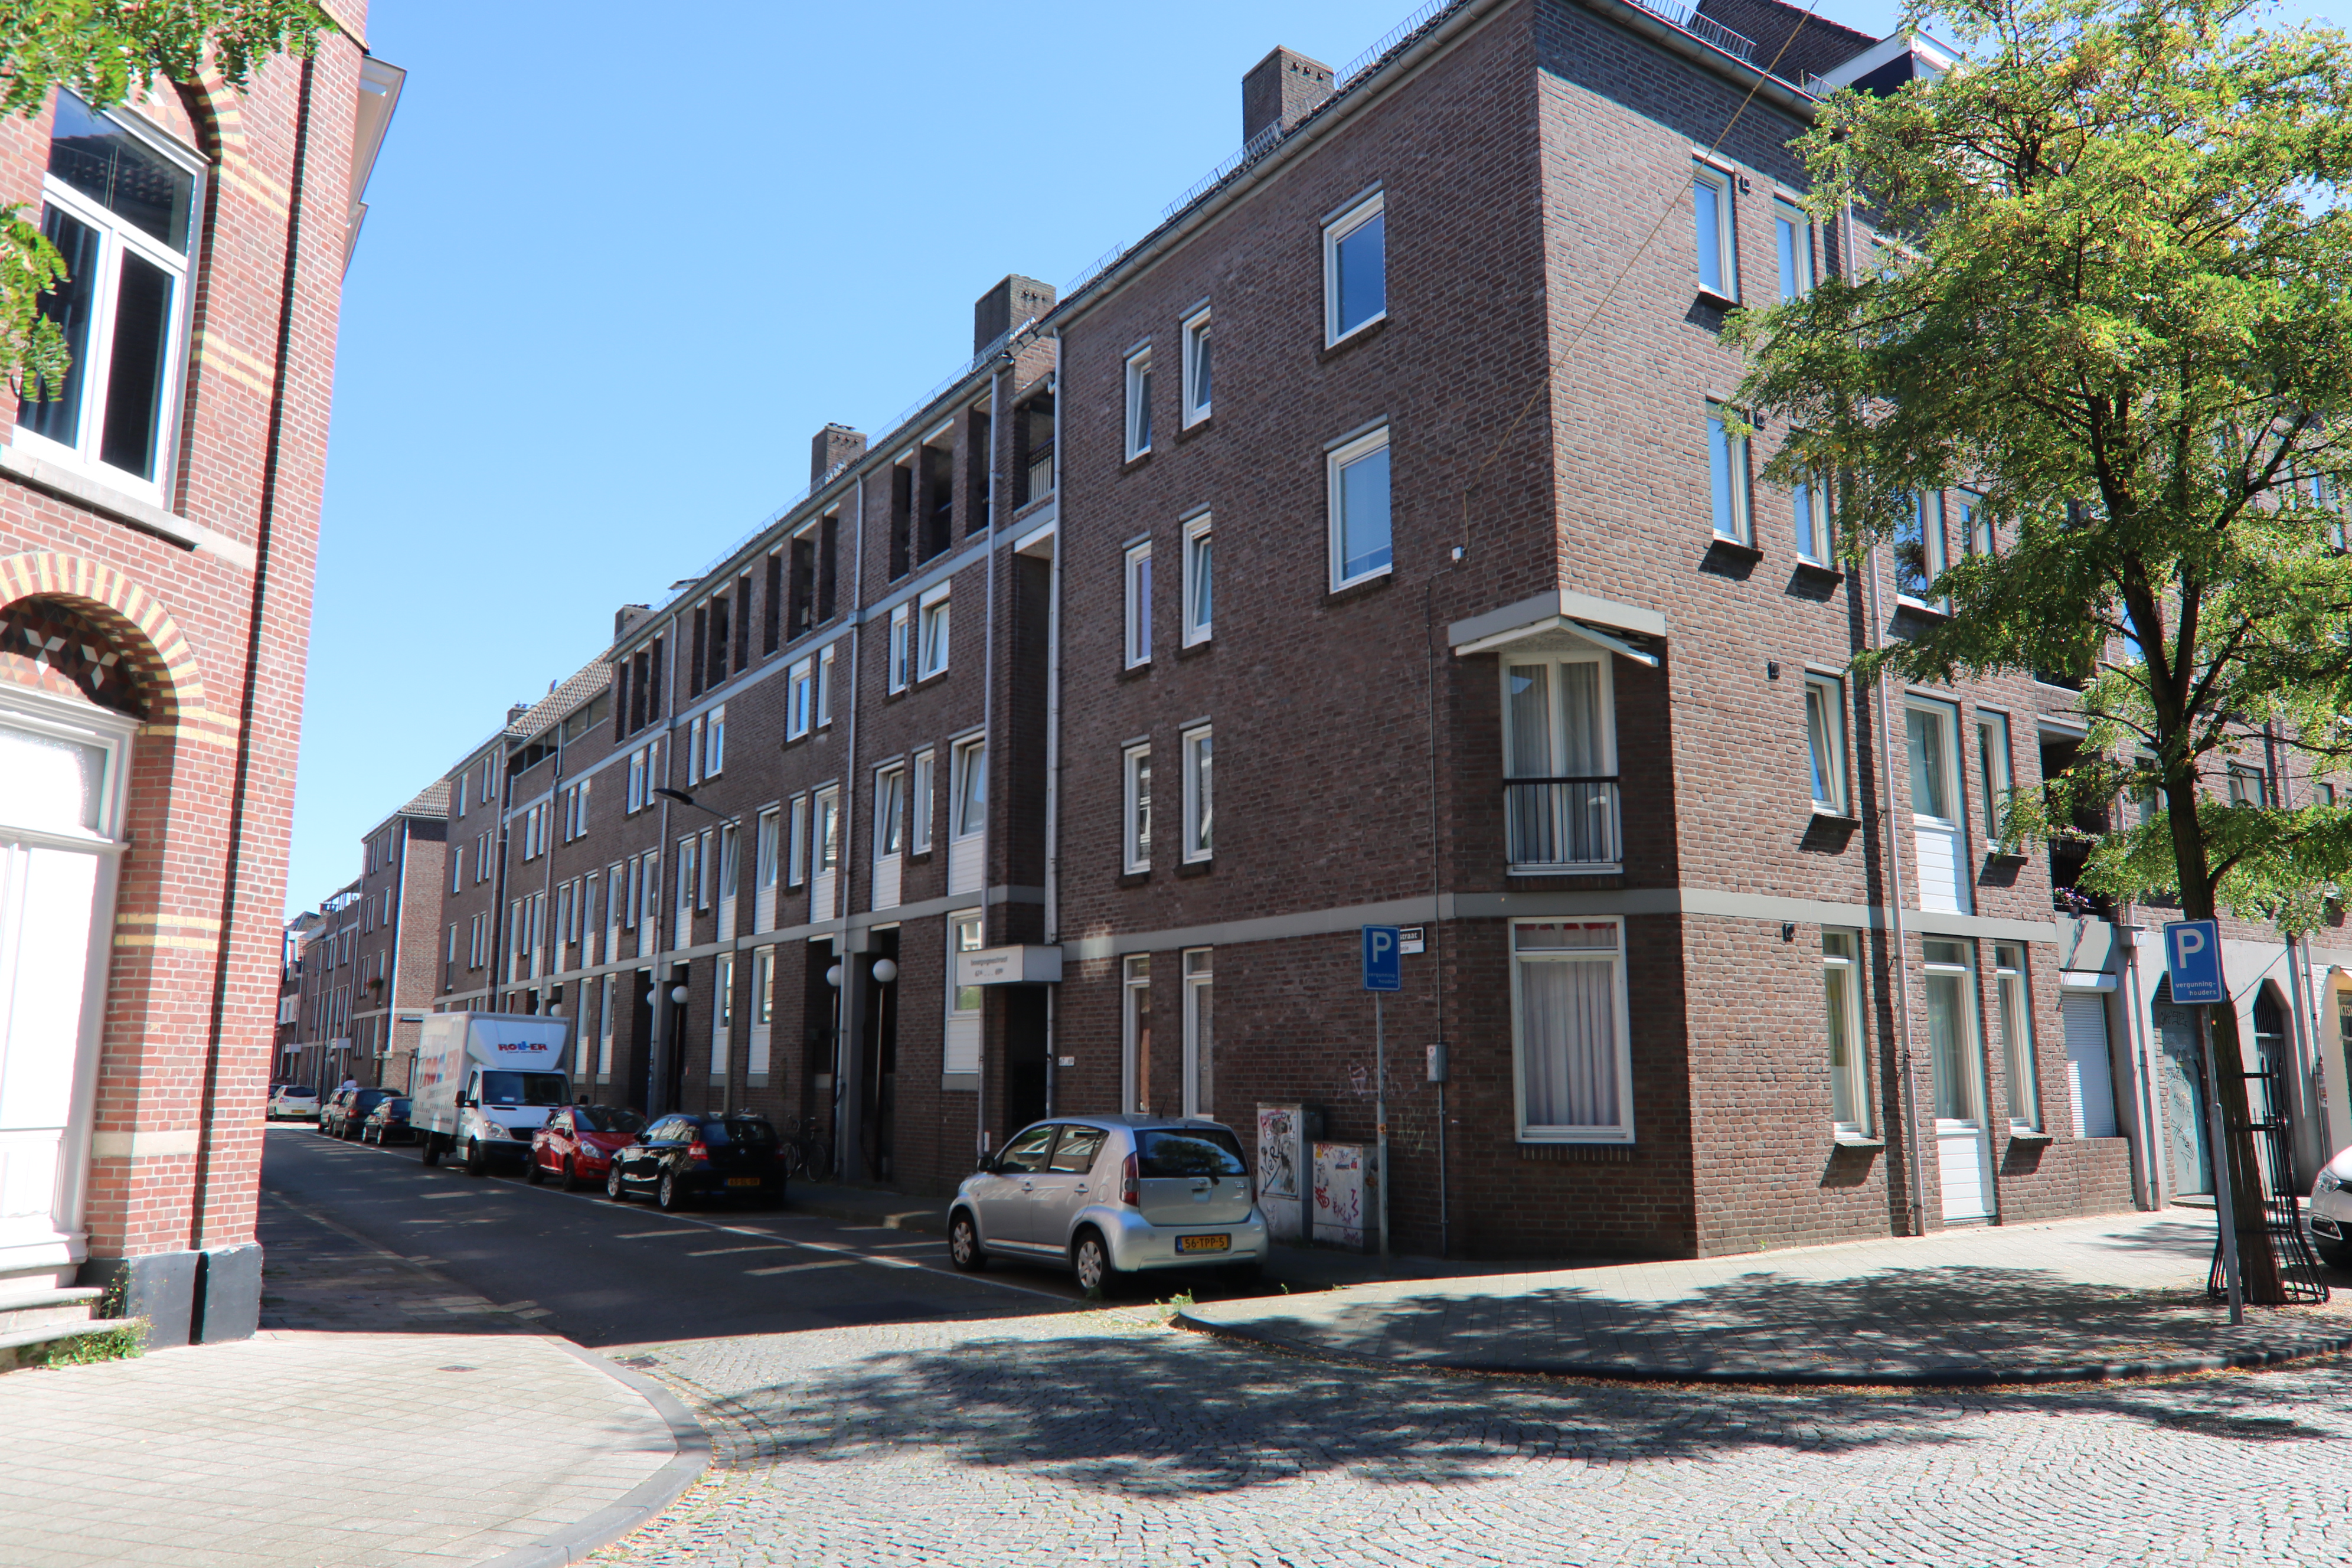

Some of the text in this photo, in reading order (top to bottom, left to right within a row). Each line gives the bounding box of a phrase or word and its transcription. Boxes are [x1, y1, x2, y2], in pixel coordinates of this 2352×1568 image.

[1373, 931, 1391, 963] P
[2176, 928, 2205, 969] P
[2175, 981, 2216, 989] vergunning-
[498, 1041, 548, 1051] ROLLER
[1185, 1237, 1224, 1248] 56-TPP-5
